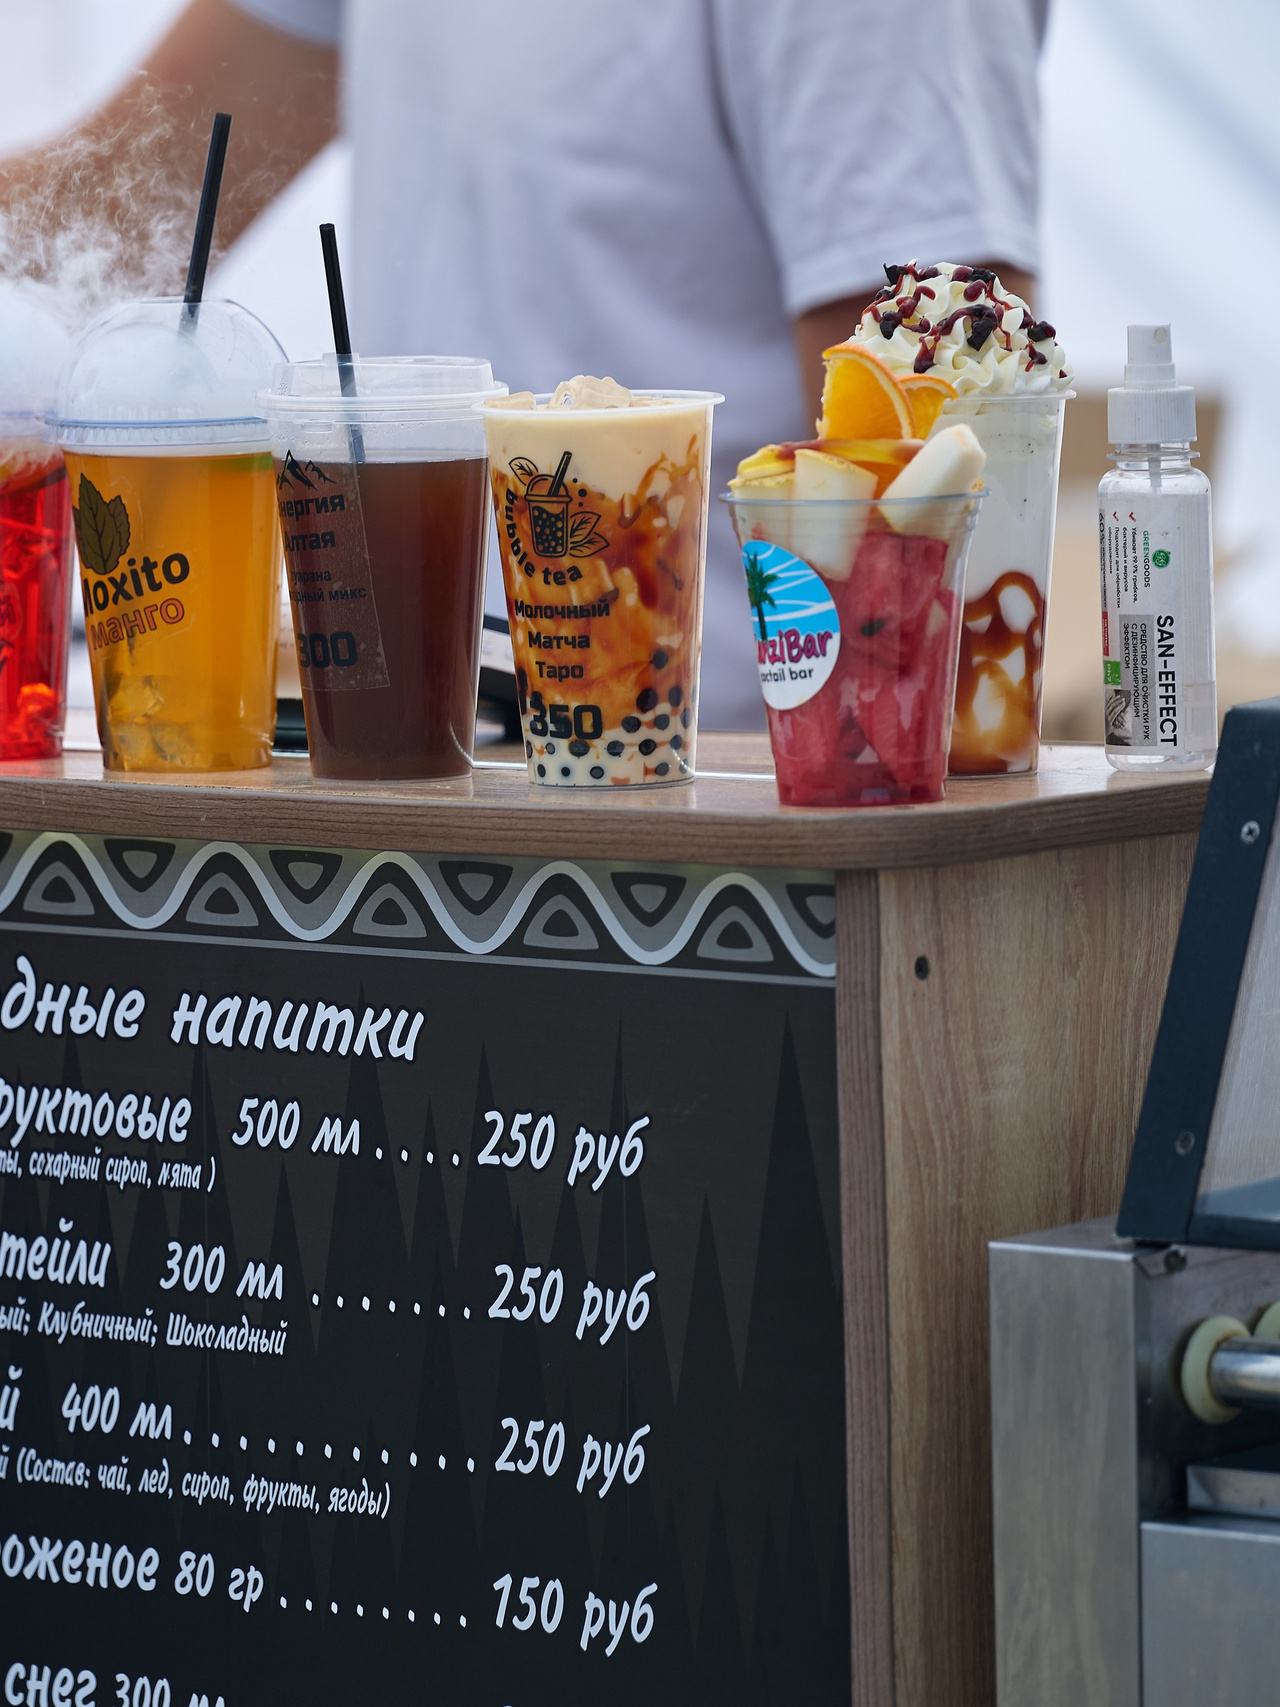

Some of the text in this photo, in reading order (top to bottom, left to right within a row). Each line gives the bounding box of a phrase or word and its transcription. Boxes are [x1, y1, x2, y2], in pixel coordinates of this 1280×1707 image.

[277, 493, 347, 521] нергия
[504, 487, 583, 586] bubble tea
[328, 586, 368, 602] микс
[514, 600, 611, 620] Молочный
[296, 631, 359, 669] 300
[528, 631, 591, 650] Матча
[1140, 623, 1148, 665] СРЕДСТВО
[535, 660, 584, 683] Таро
[788, 667, 814, 680] bar
[1131, 631, 1140, 717] ДЕЗИНФИЦИРУЮЩИМ
[1157, 615, 1177, 746] SAN-EFFECT
[529, 703, 603, 740] 350
[170, 993, 425, 1061] напитки
[231, 1097, 300, 1150] 500
[311, 1116, 360, 1156] мл
[477, 1110, 556, 1170] 250
[567, 1116, 650, 1192] руб
[105, 1155, 152, 1190] сироп,
[159, 1241, 226, 1294] 300
[235, 1261, 283, 1301] мл
[487, 1263, 564, 1324] 250
[575, 1270, 656, 1346] руб
[37, 1301, 158, 1348] Клубничный;
[166, 1312, 288, 1356] Шоколадный
[61, 1382, 120, 1434] 400
[128, 1401, 172, 1440] мл
[494, 1417, 566, 1477] 250
[576, 1423, 651, 1499] руб
[16, 1446, 91, 1489] (Состав:
[97, 1455, 132, 1495] чай,
[138, 1457, 173, 1500] лед,
[181, 1471, 234, 1506] сироп,
[242, 1473, 320, 1515] фрукты,
[327, 1477, 391, 1520] ягоды)
[174, 1550, 215, 1597] 80
[228, 1565, 264, 1613] гр
[492, 1573, 564, 1634] 150
[579, 1582, 658, 1657] руб
[4, 1662, 97, 1707] снег
[115, 1673, 171, 1707] 300
